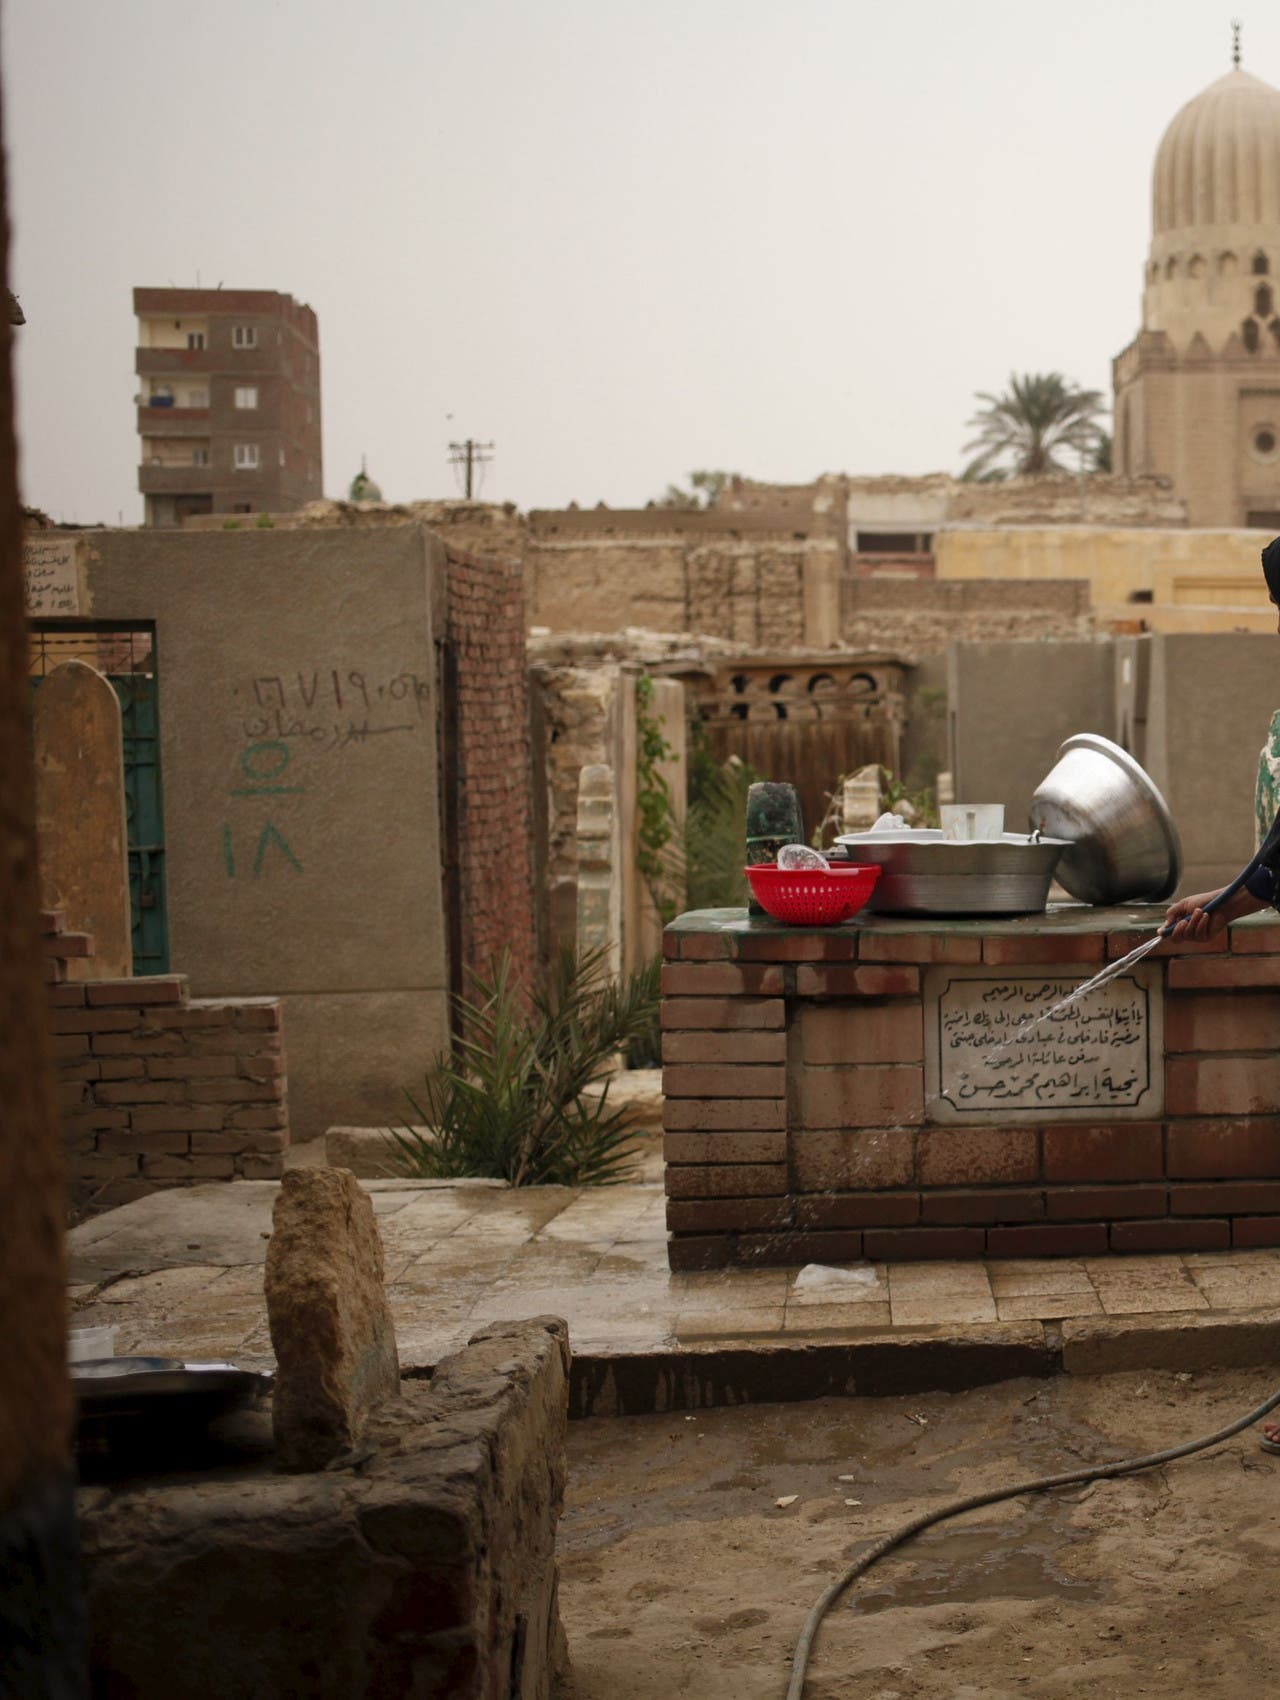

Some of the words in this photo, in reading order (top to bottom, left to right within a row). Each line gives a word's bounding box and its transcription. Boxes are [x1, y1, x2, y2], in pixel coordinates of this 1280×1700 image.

[224, 820, 304, 879] ١٨
[982, 985, 1023, 1002] الرحيم
[1024, 983, 1062, 1002] الرحمن
[958, 1072, 1006, 1098] حسن
[1101, 1067, 1139, 1100] نجية
